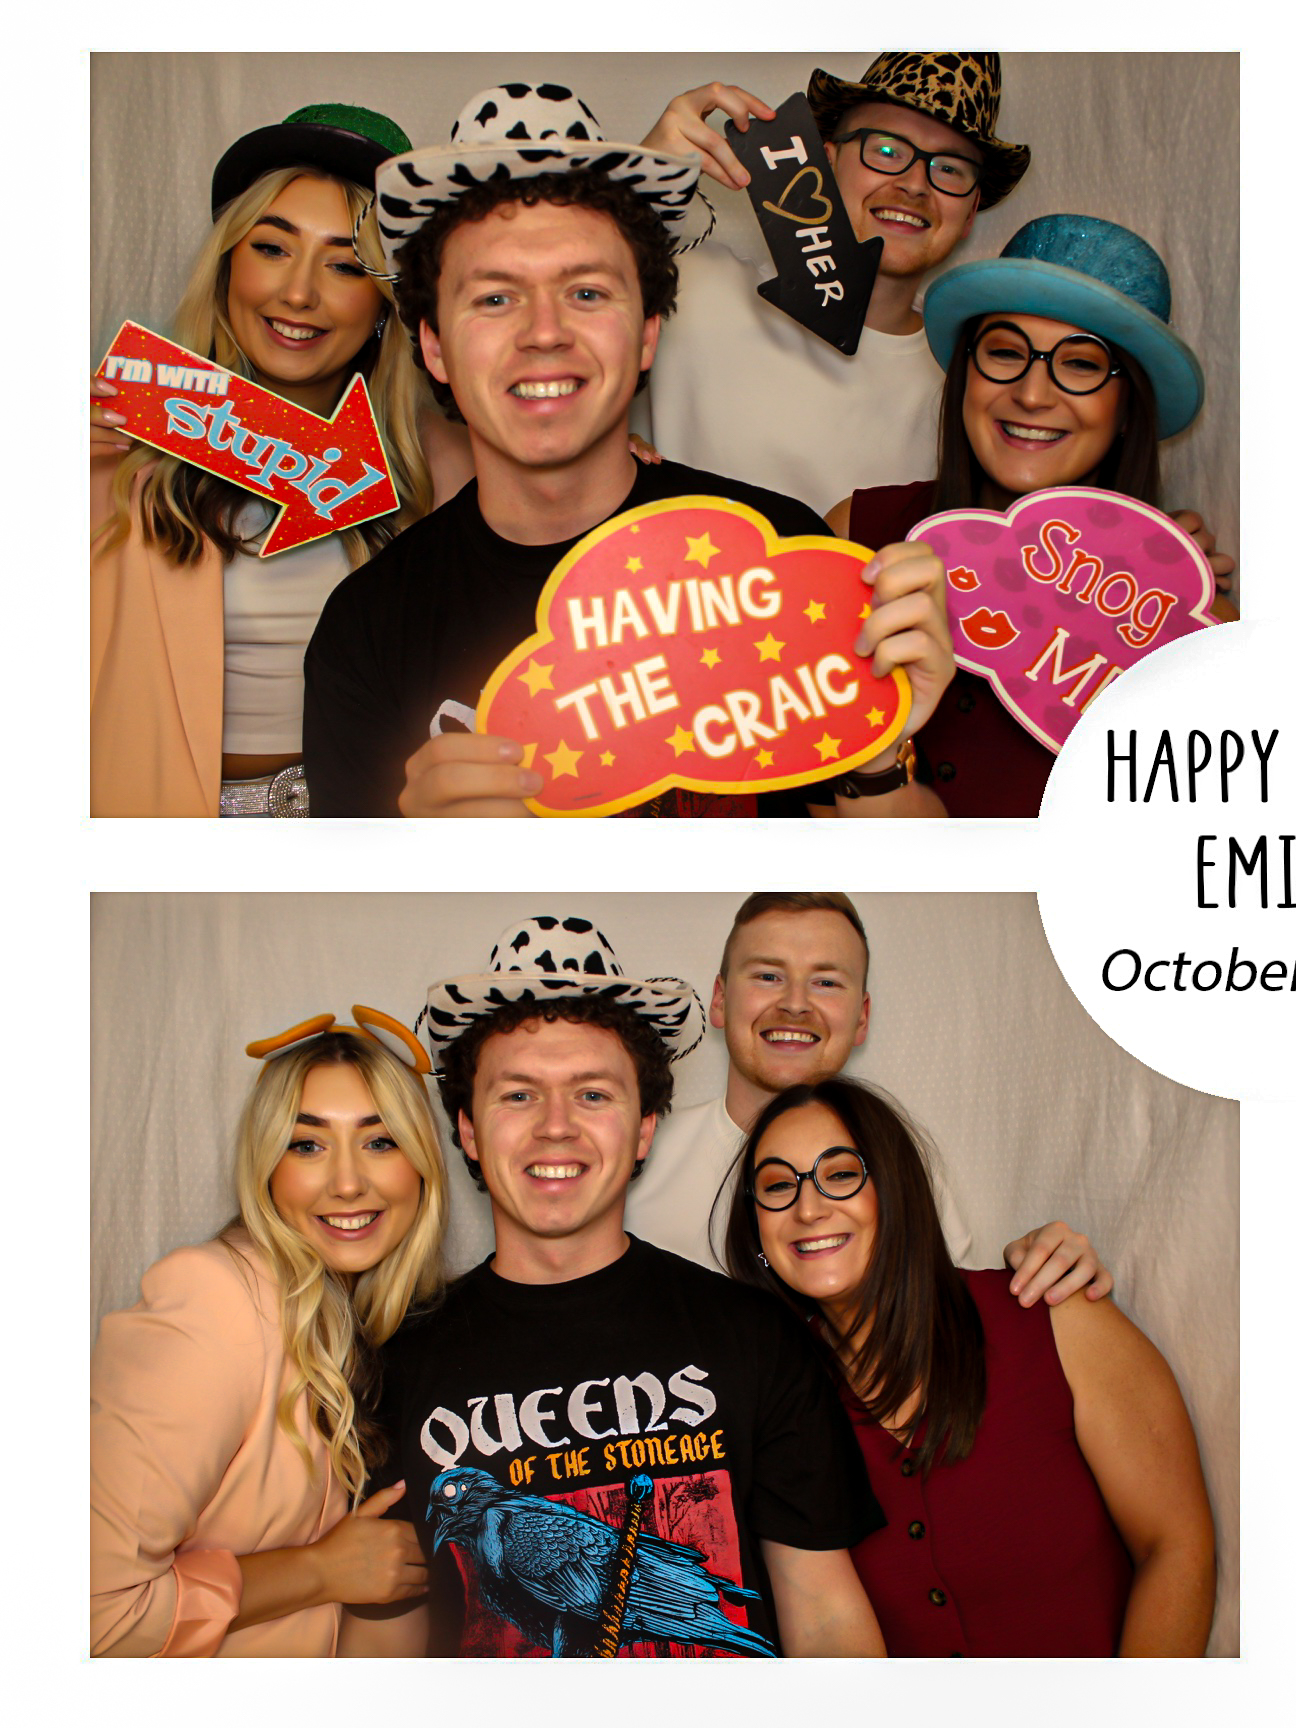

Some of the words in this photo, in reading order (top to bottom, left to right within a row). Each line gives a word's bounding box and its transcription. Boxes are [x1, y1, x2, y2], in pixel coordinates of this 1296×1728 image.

[760, 136, 808, 170] I
[795, 226, 844, 307] HER
[157, 364, 231, 396] WITH
[164, 398, 386, 521] stupid
[567, 567, 782, 652] HAVING
[1021, 519, 1179, 648] Snog
[554, 655, 680, 742] THE
[691, 654, 860, 760] CRAIC
[420, 1364, 717, 1472] QUEENS
[509, 1455, 537, 1486] OF
[544, 1446, 591, 1480] THE
